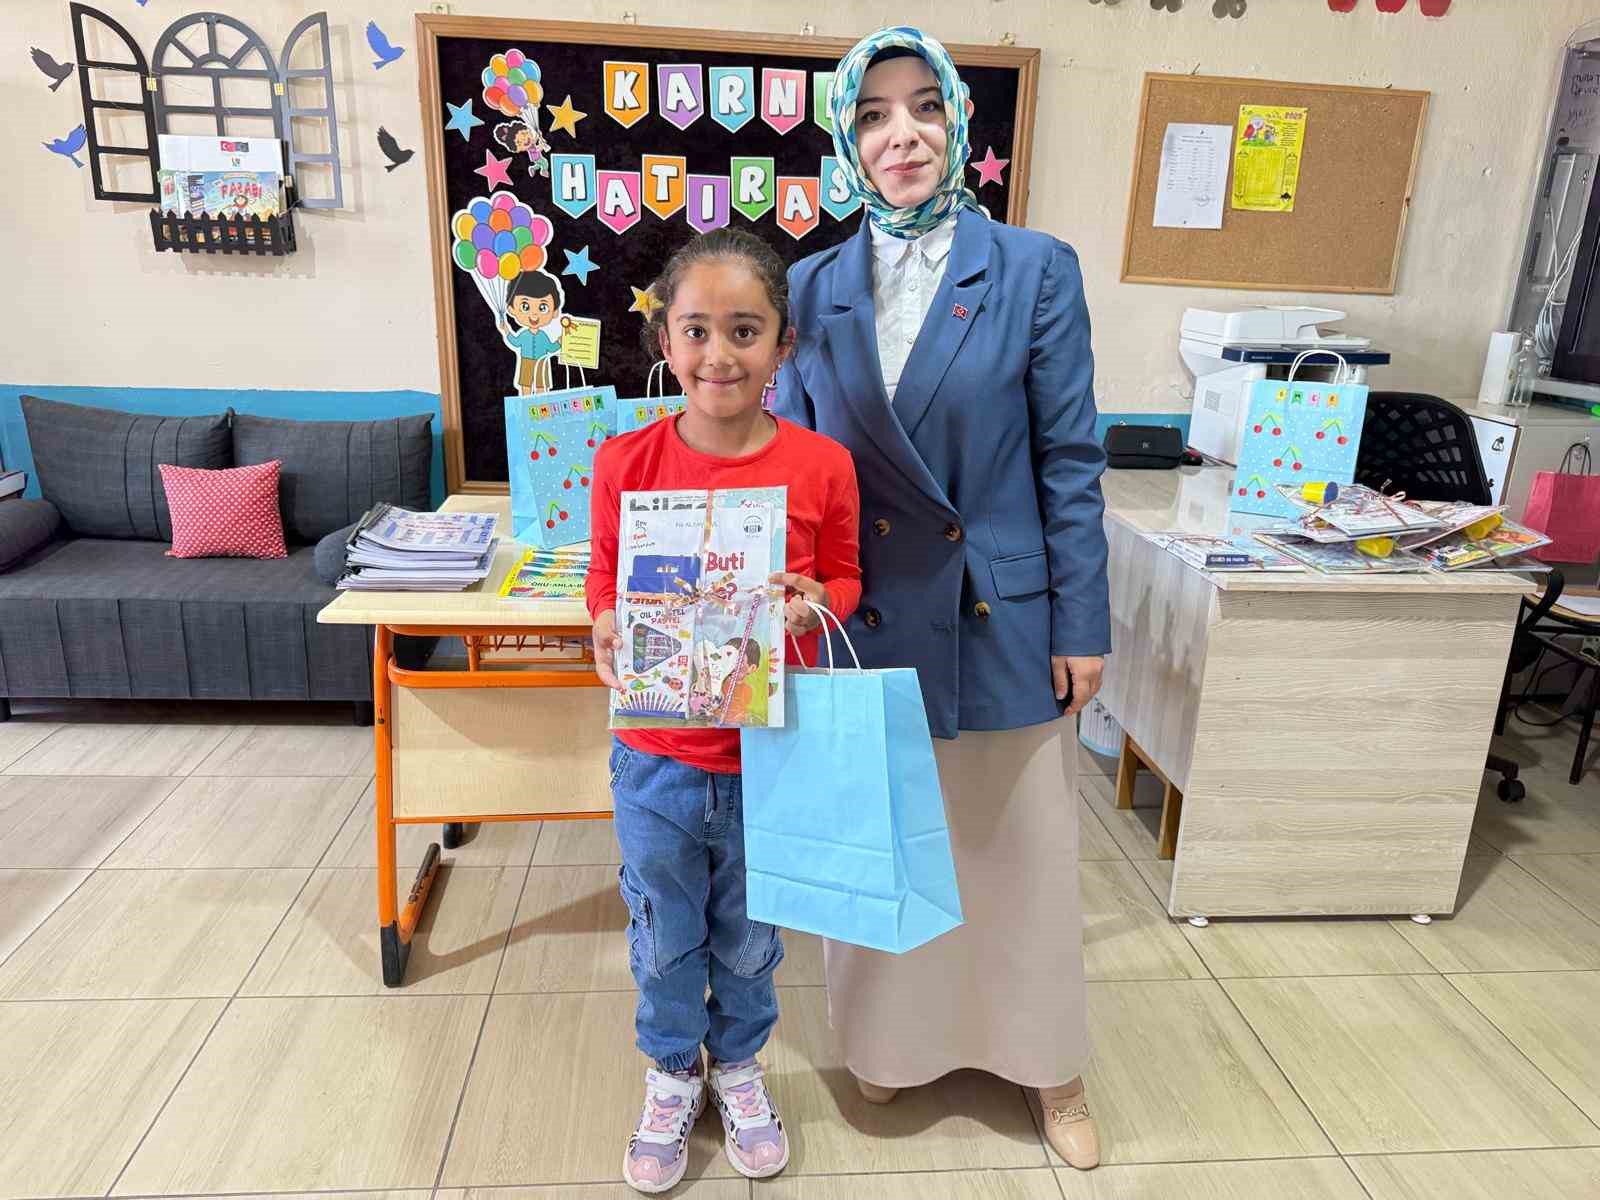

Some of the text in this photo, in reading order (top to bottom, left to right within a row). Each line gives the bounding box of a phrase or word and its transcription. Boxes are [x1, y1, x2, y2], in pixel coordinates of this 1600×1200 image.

[612, 69, 833, 118] KARN
[705, 552, 745, 573] Buti
[655, 608, 686, 618] PTEL
